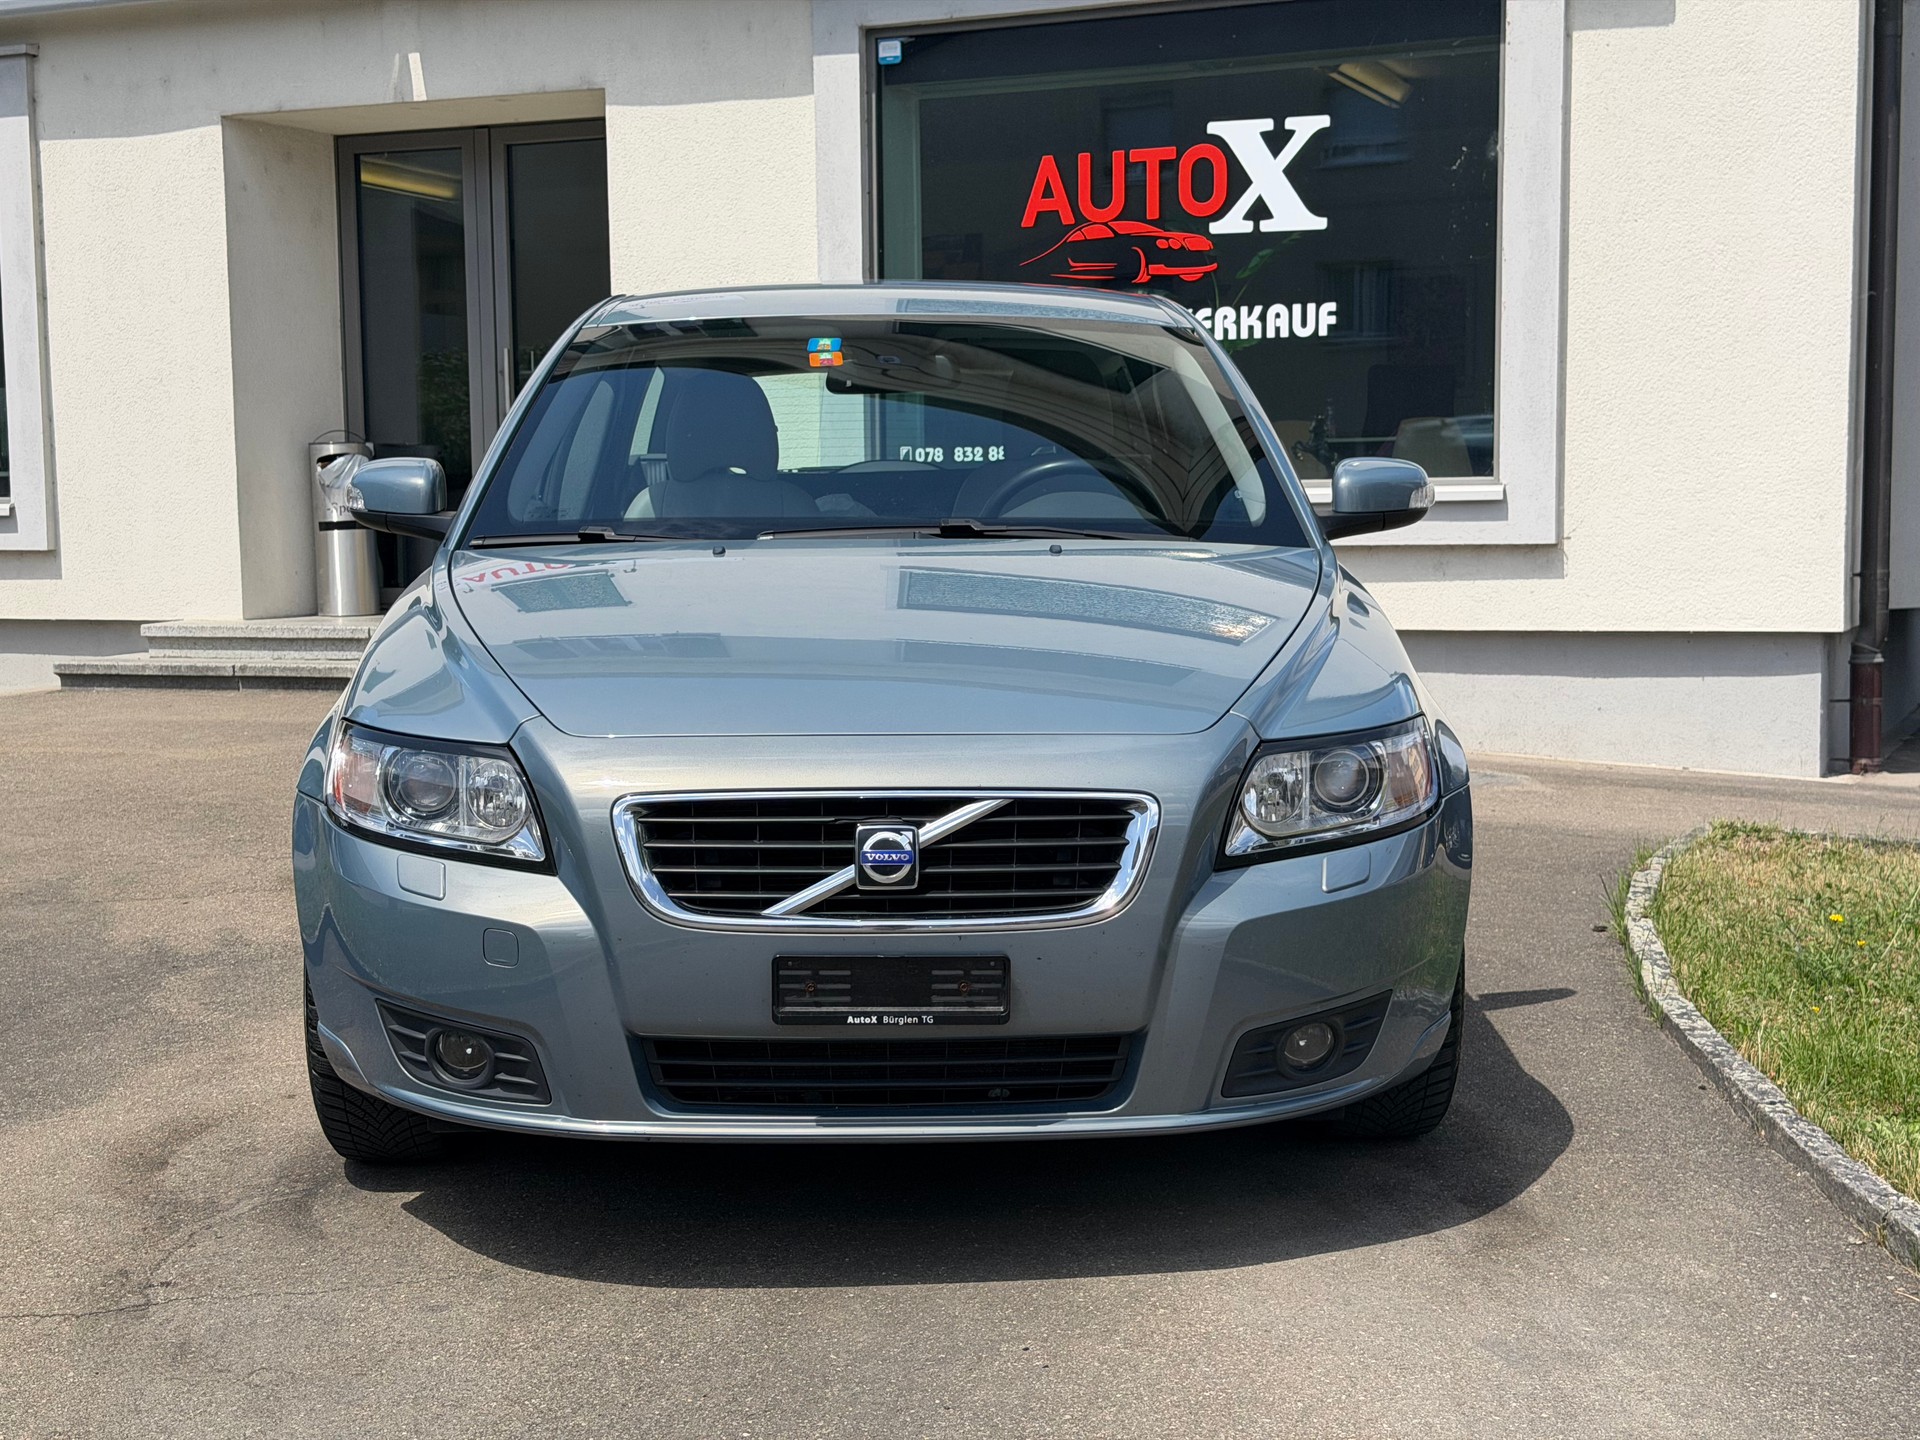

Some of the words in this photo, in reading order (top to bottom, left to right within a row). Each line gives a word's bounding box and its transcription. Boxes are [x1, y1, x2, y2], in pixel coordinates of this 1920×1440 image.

[1188, 302, 1337, 341] ERKAUF
[915, 447, 944, 462] 078
[953, 446, 984, 462] 832
[865, 853, 910, 861] VOLVO
[847, 1015, 878, 1024] AutoX
[882, 1015, 919, 1026] Bürglen
[921, 1015, 934, 1024] TG
